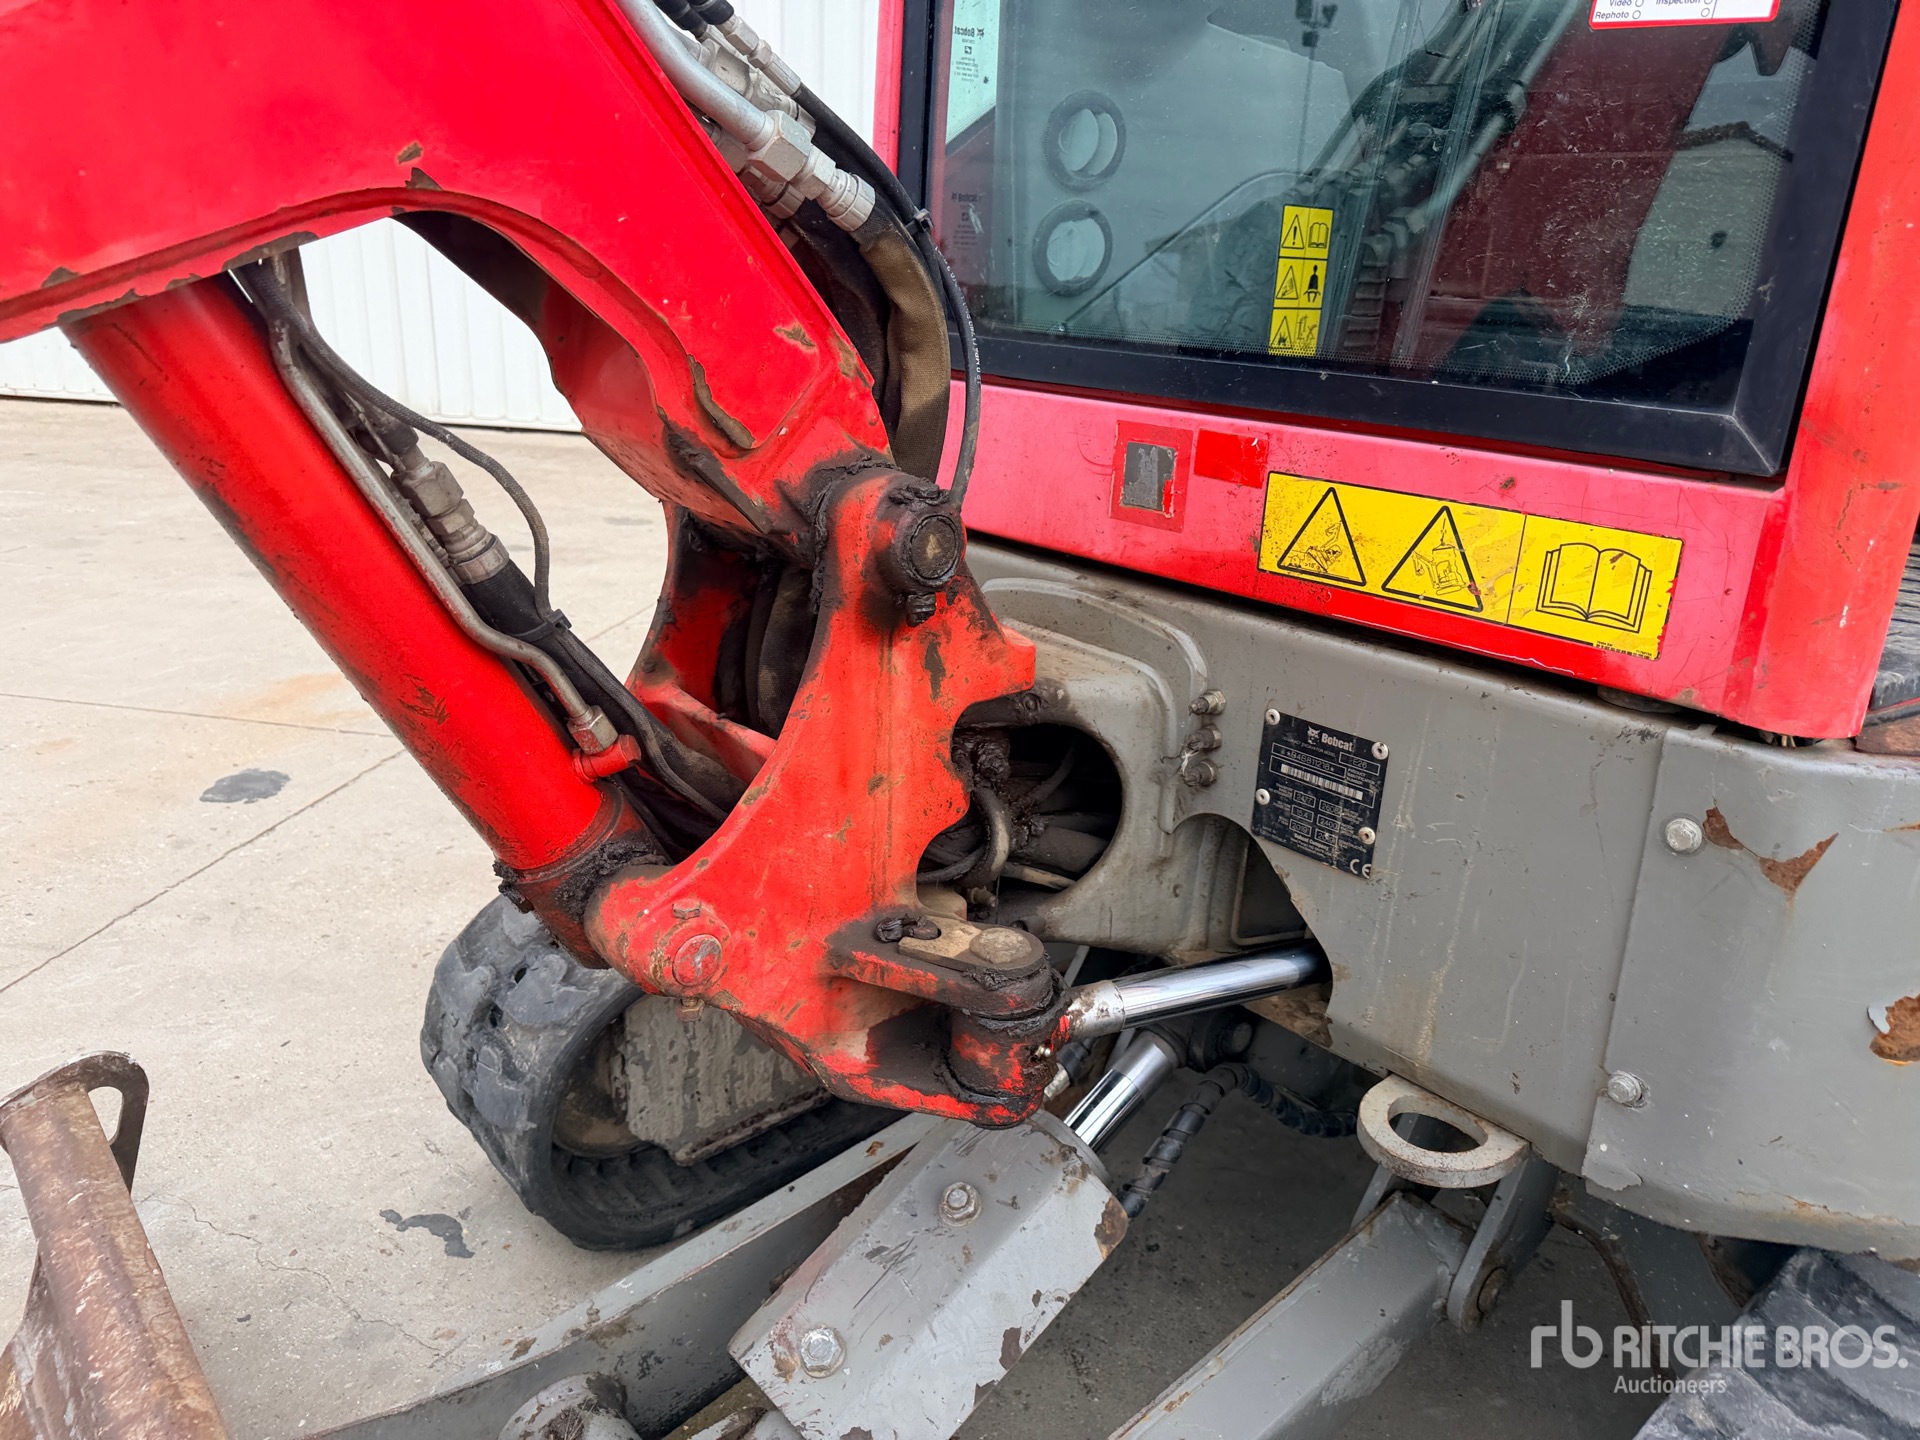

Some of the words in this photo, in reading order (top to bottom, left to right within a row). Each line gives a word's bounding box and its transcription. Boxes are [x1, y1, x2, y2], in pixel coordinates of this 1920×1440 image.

[1595, 11, 1630, 20] Rephoto
[1320, 732, 1353, 752] Bobcat
[1352, 758, 1367, 769] E26
[1296, 793, 1312, 805] 2477
[1320, 817, 1337, 829] 2400
